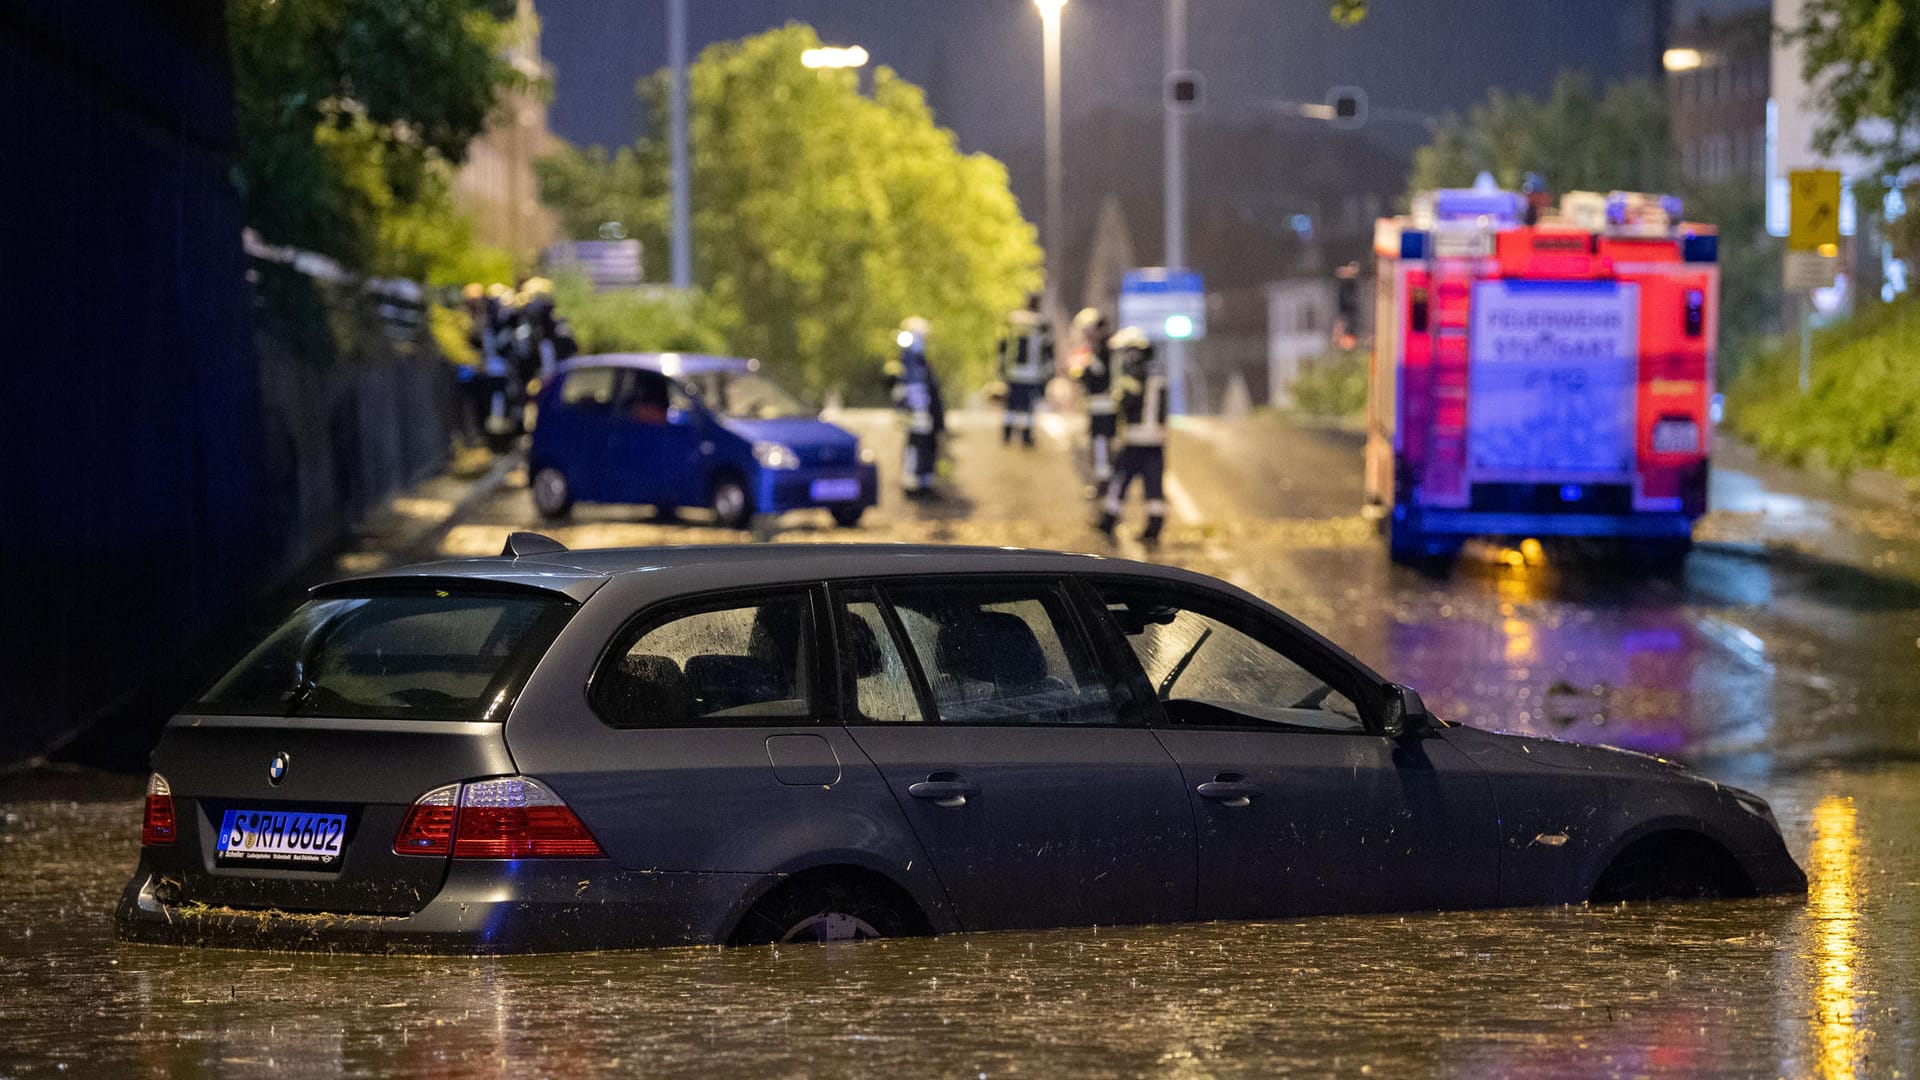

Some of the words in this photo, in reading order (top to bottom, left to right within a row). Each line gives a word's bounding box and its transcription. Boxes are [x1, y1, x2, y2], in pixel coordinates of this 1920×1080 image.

[1487, 310, 1622, 331] FEUERWEHR
[1494, 335, 1617, 358] STUTTGART
[231, 814, 248, 847] S
[256, 815, 287, 848] RH
[287, 817, 343, 851] 6602
